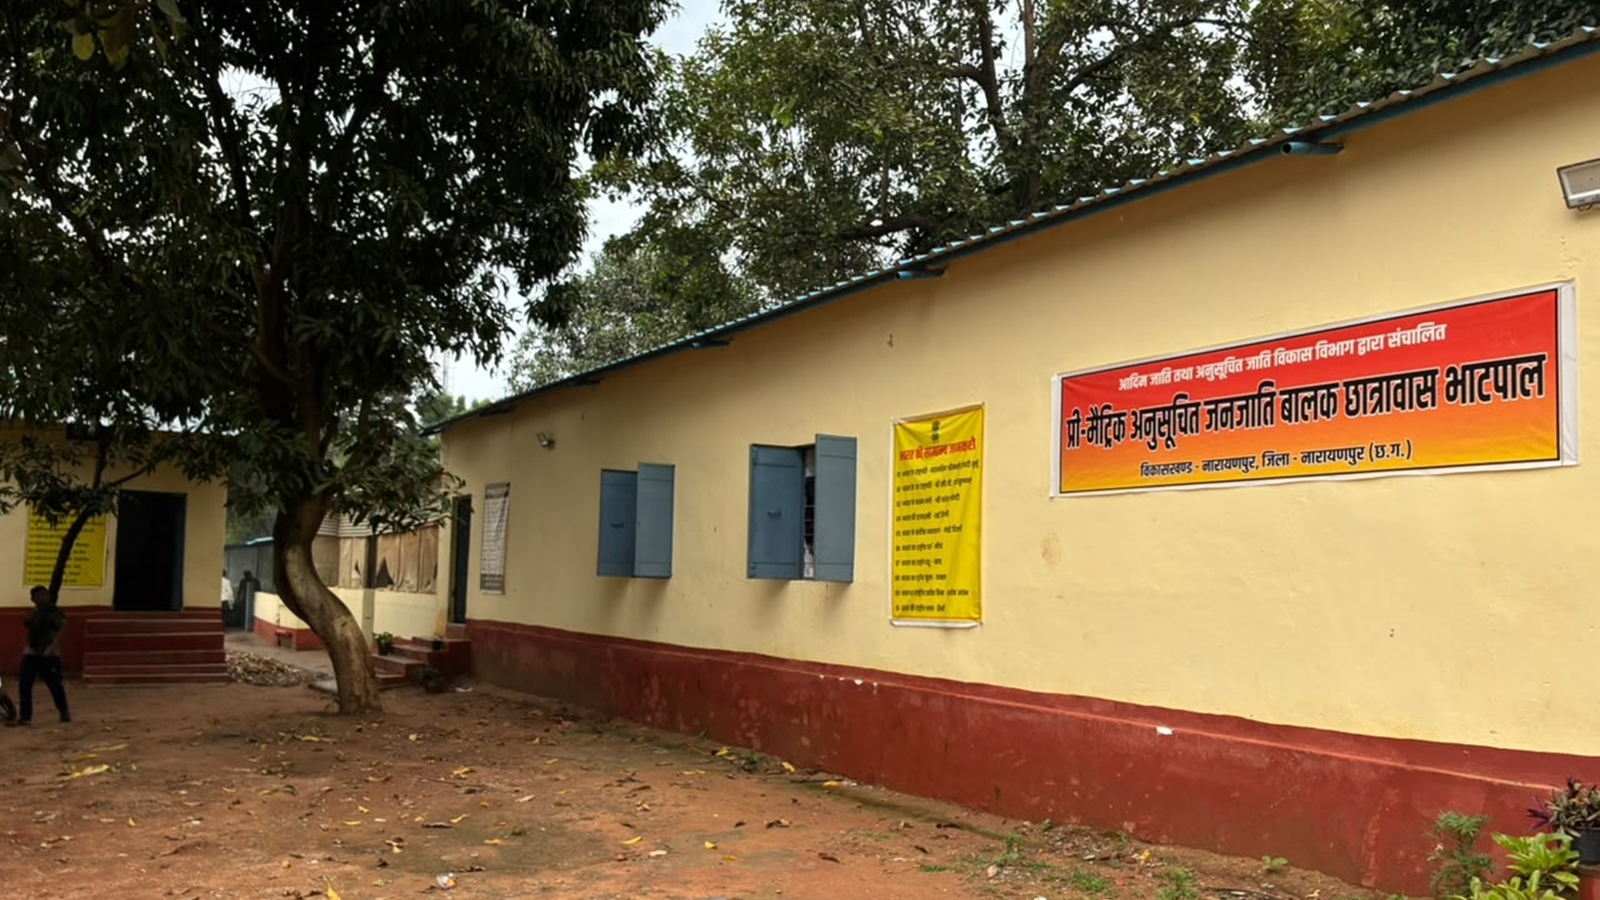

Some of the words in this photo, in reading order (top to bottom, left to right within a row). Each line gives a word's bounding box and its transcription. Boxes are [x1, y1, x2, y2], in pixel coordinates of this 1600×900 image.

[1118, 372, 1148, 391] आदिम
[1149, 367, 1172, 386] जाति
[1173, 366, 1193, 381] तथा
[1195, 357, 1244, 381] अनुसूचित
[1245, 349, 1272, 370] जाति
[1273, 345, 1313, 367] विकास
[1315, 338, 1356, 360] विभाग
[1356, 333, 1385, 356] द्वारा
[1387, 321, 1448, 348] संचालित
[1066, 403, 1128, 450] प्री-मैट्रिक
[1130, 393, 1202, 451] अनुसूचित
[1203, 379, 1279, 434] जनजाति
[1280, 381, 1341, 424] बालक
[1343, 367, 1440, 418] छात्रावास
[1444, 353, 1548, 405] भाटपाल
[1140, 461, 1193, 478] विकासखण्ड
[1201, 455, 1259, 476] नारायणपुर,
[1262, 451, 1290, 468] जिला
[1301, 444, 1366, 466] नारायणपुर
[1368, 439, 1413, 462] (छ.ग.)
